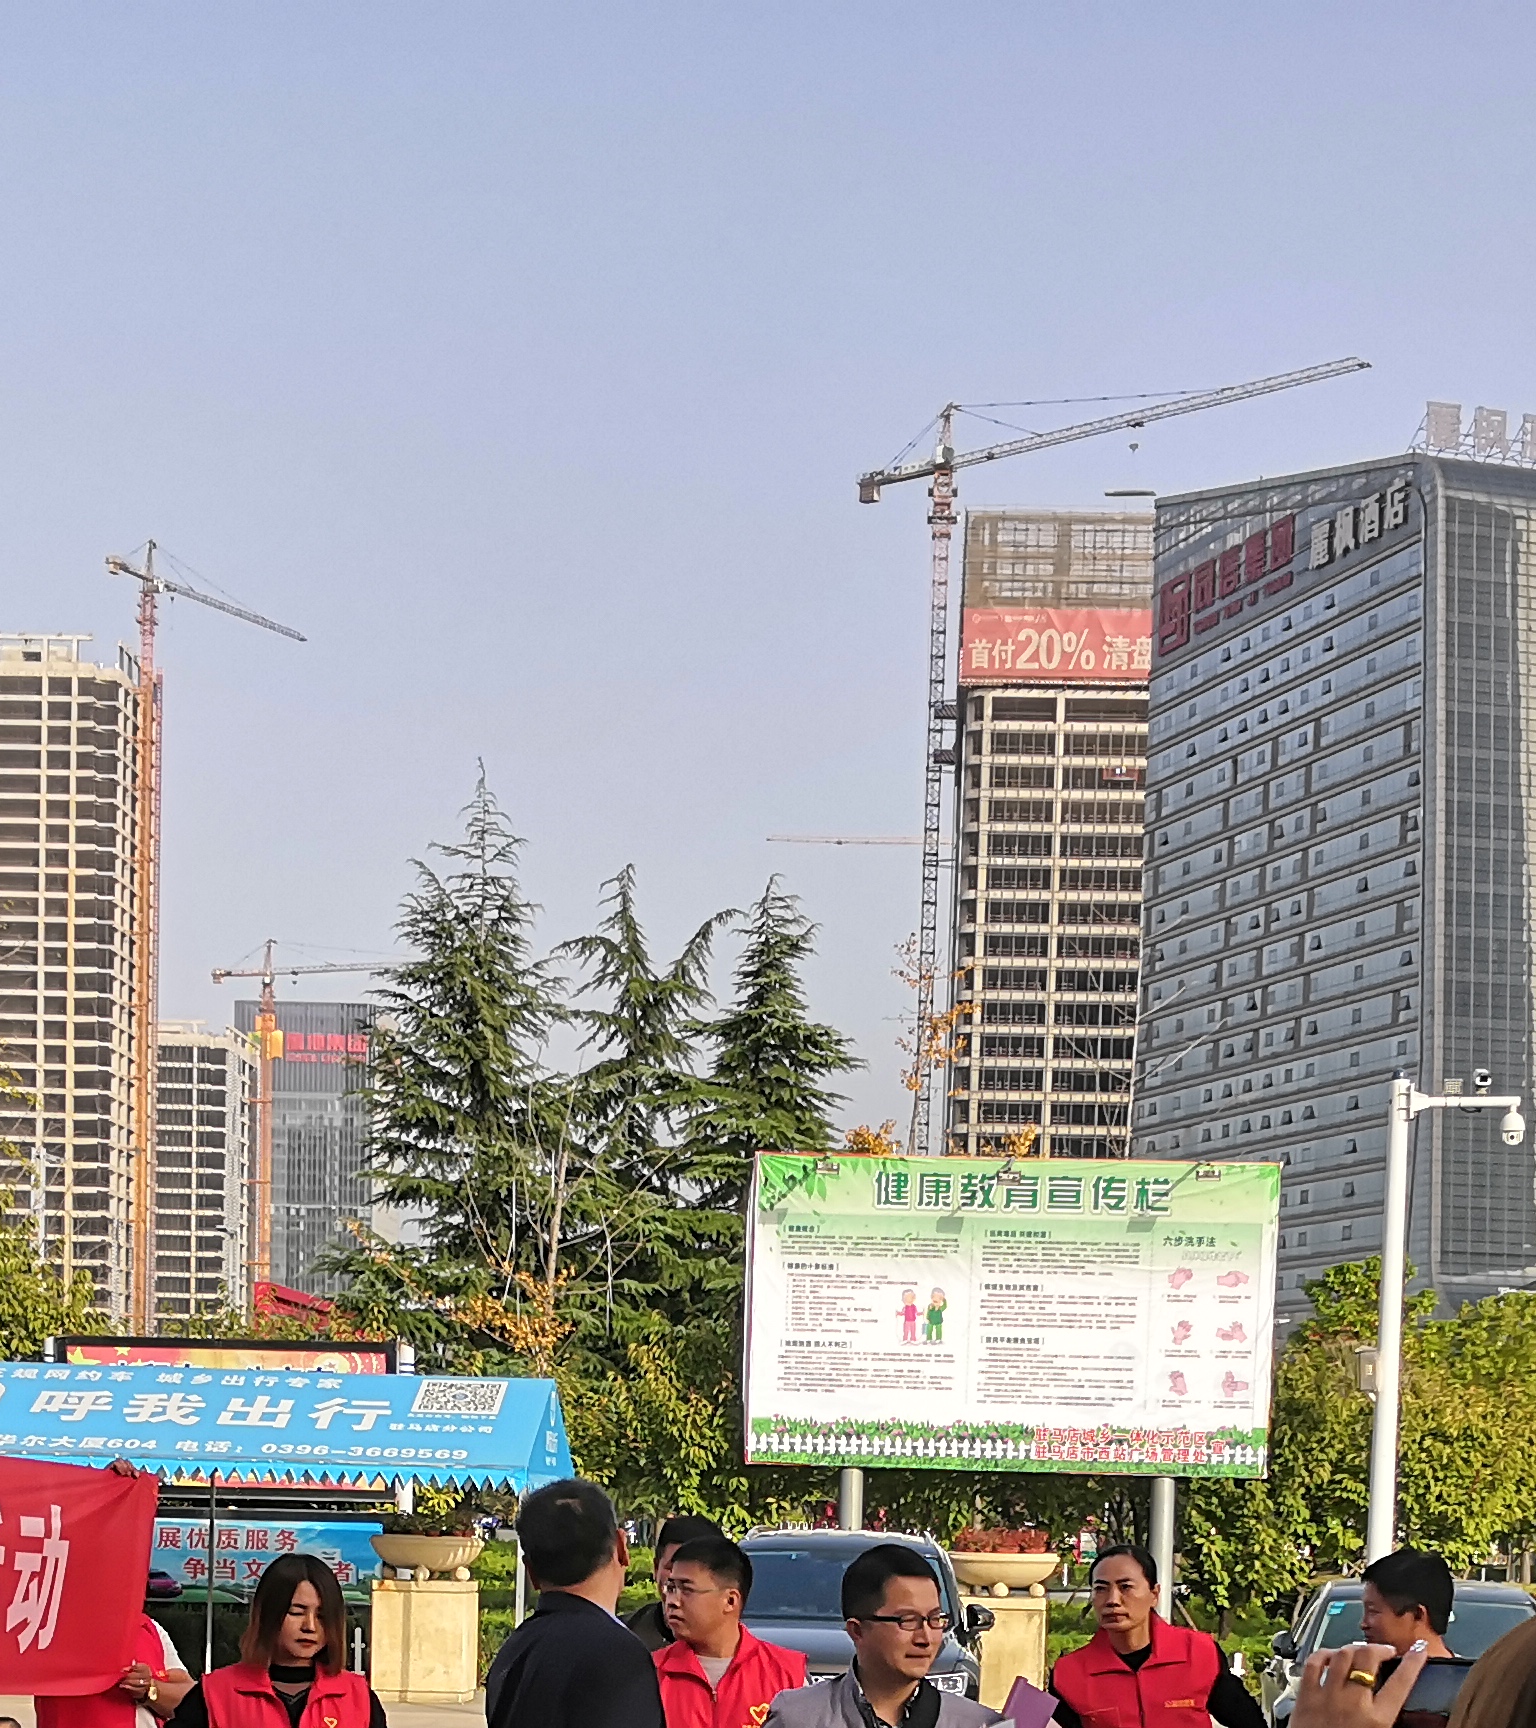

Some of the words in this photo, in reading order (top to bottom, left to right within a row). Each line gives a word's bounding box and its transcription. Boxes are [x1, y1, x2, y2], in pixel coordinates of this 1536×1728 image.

[969, 628, 1095, 670] 首付20%
[874, 1171, 1172, 1214] 健康教育宣传栏
[30, 1391, 391, 1431] 呼我出行
[1035, 1428, 1206, 1446] 驻马店城乡一体化示范区
[261, 1443, 468, 1460] 0396-3669569
[1035, 1445, 1206, 1463] 驻马店市西站广场管理处
[157, 1527, 298, 1551] 展优质服务
